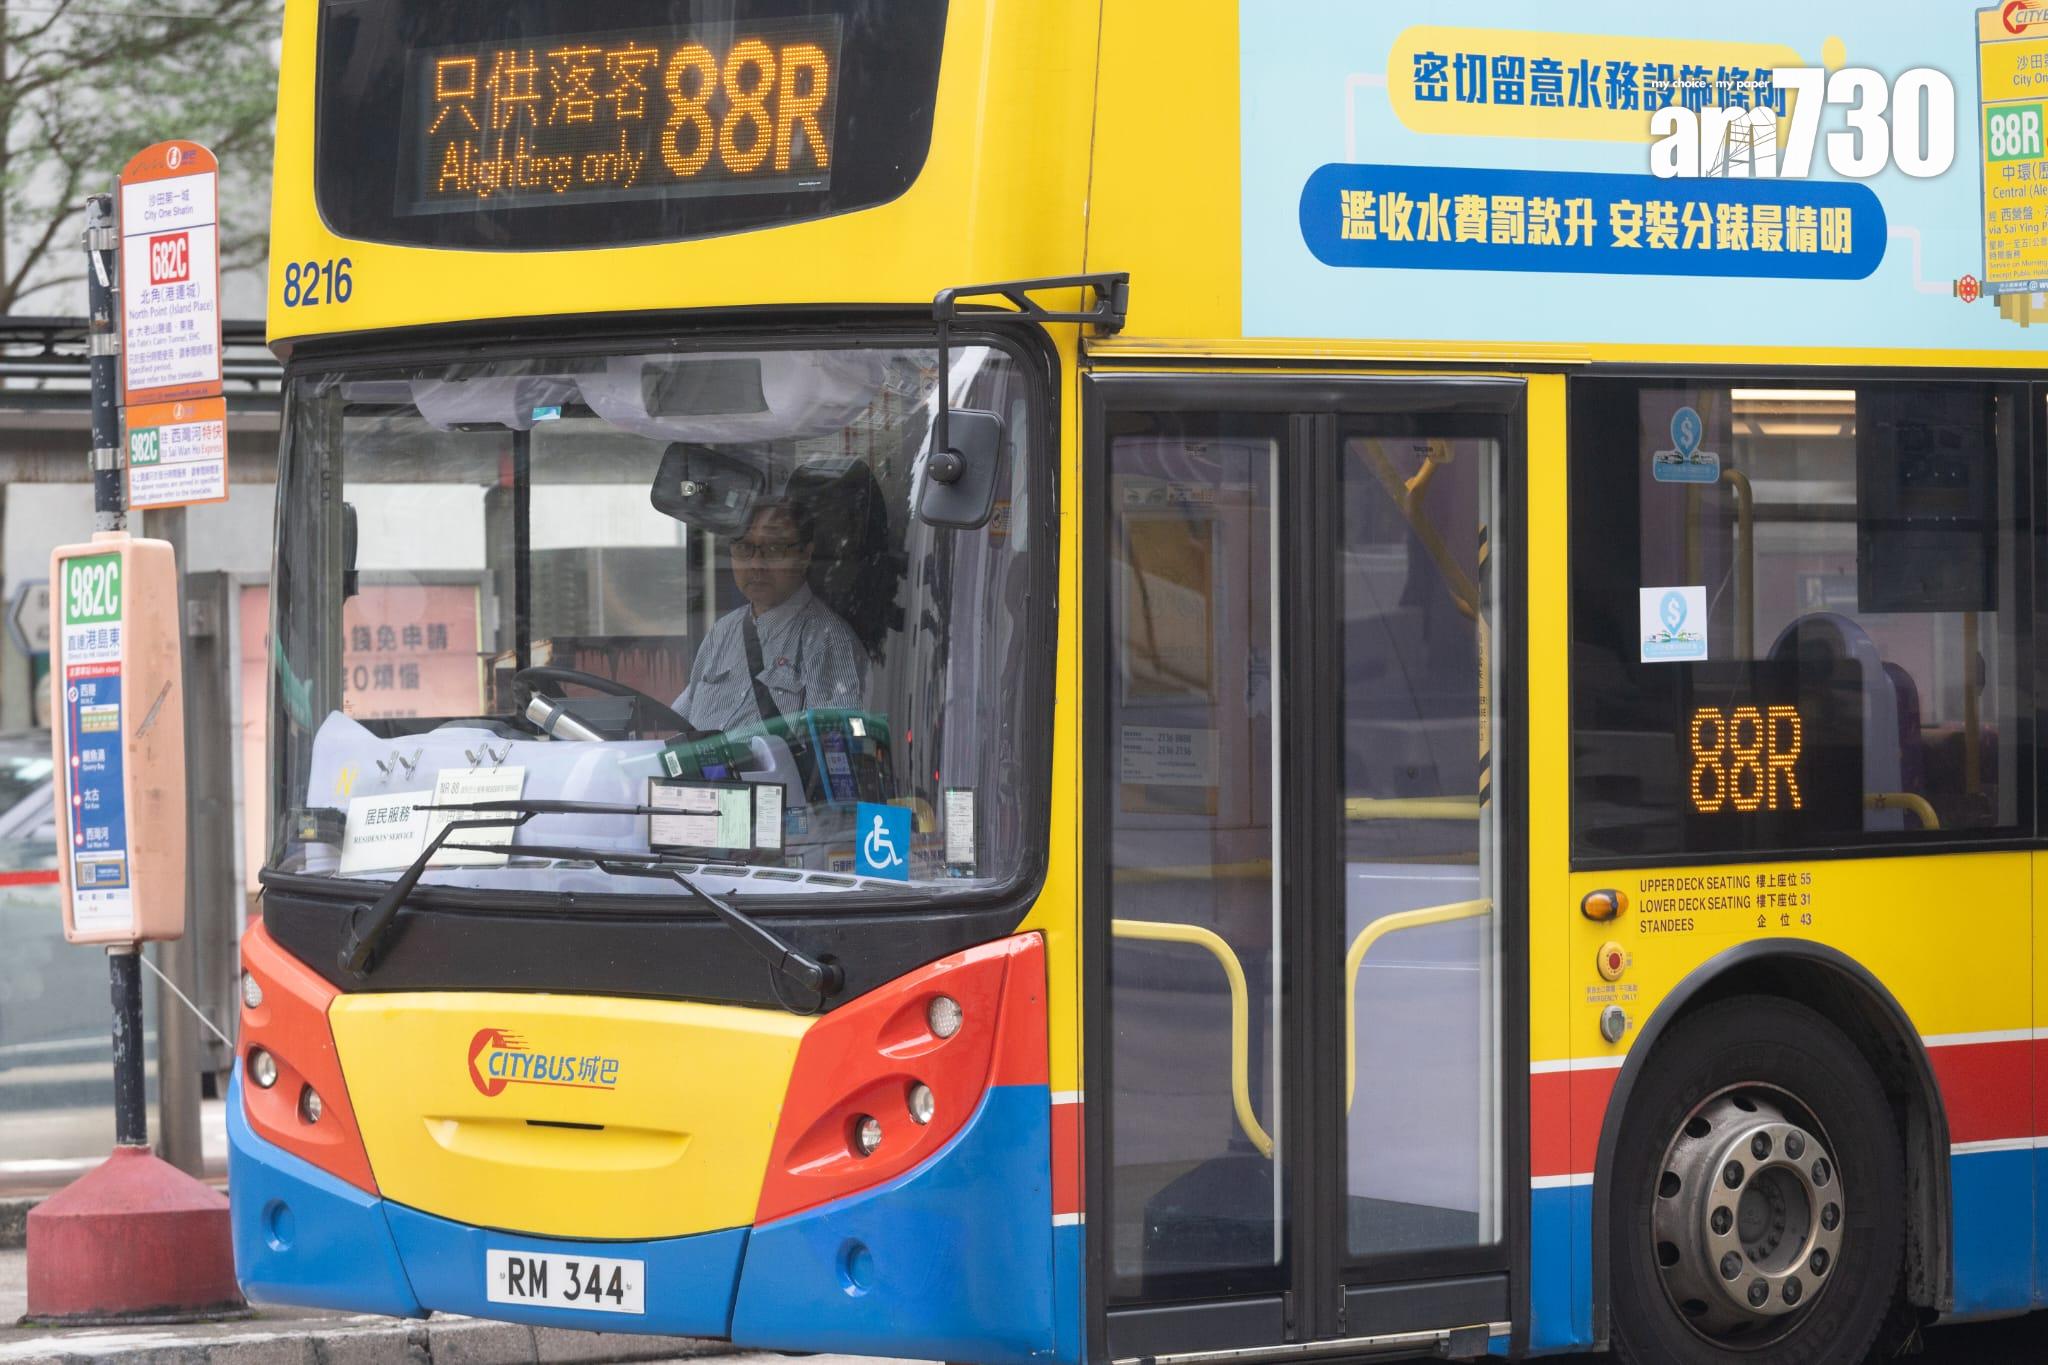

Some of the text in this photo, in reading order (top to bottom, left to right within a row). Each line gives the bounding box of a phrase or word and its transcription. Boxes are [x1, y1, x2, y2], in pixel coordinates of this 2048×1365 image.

[1413, 51, 1786, 118] 密切留意水務設施條例
[2013, 75, 2031, 87] City
[428, 39, 830, 177] 只供落客 88R
[1990, 110, 2040, 157] 88R
[438, 129, 645, 198] Alighting only
[1993, 185, 2027, 199] Central
[144, 205, 194, 222] City One Shatin
[1340, 189, 1853, 254] 濫收水費罰款升 安裝分錶最精明
[2004, 224, 2017, 234] Sai
[2019, 223, 2039, 235] Ying
[152, 238, 187, 281] 682C
[284, 257, 353, 308] 8216
[129, 308, 148, 320] North
[150, 306, 168, 317] Point
[131, 429, 158, 463] 982C
[70, 560, 118, 618] 982C
[343, 623, 448, 652] 錢免申請
[1691, 704, 1803, 813] 88R
[366, 806, 411, 825] 居民服務
[1640, 872, 1812, 893] UPPER DECK SEATING 樓上座位 55
[1640, 893, 1811, 913] LOWER DECK SEATING 樓下座位 31
[1640, 912, 1812, 933] STANDEES 企 位 43
[488, 1050, 620, 1085] CITYBUS 城巴
[507, 1256, 624, 1305] RM 344
